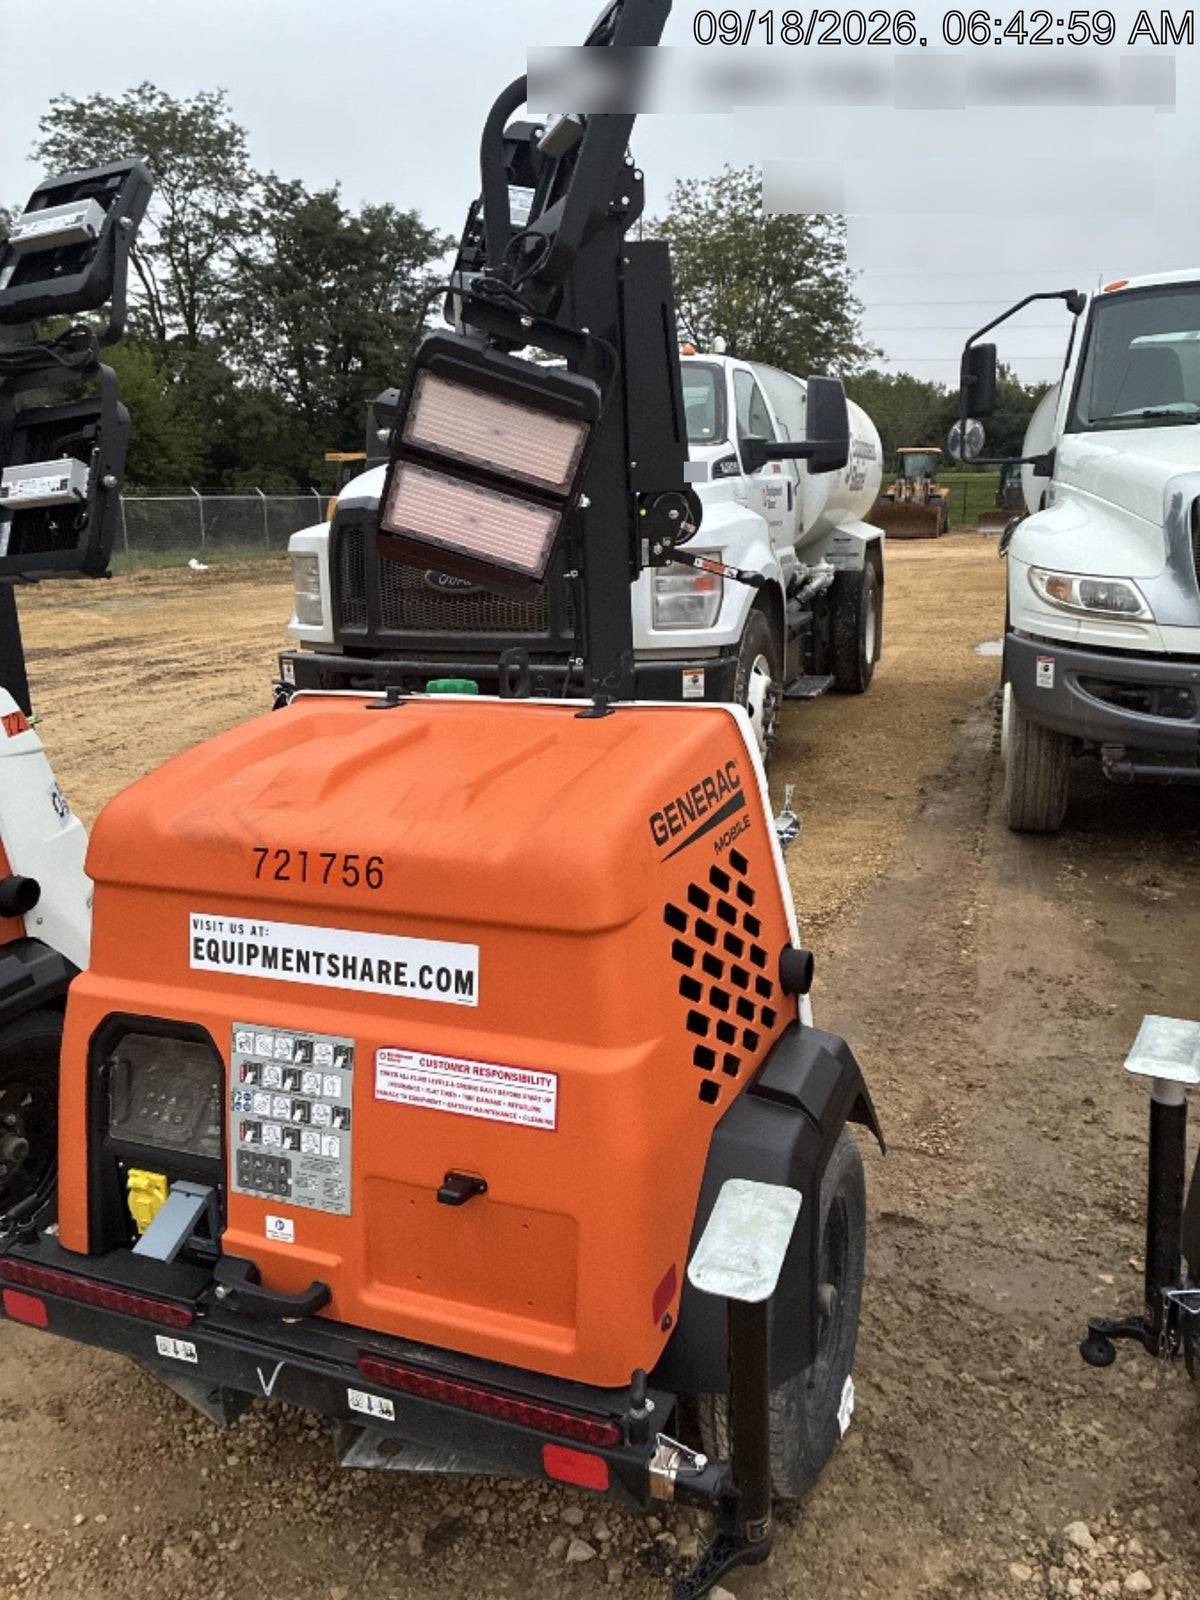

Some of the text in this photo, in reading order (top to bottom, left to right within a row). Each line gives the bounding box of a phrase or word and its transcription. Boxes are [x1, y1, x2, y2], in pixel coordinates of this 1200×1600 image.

[649, 760, 740, 847] GENERAC
[713, 814, 751, 856] MOBILE
[253, 848, 385, 889] 721756
[193, 919, 269, 937] VISIT US AT:
[193, 937, 474, 996] EQUIPMENTSHARE.COM
[418, 1057, 470, 1073] CUSTOMER
[472, 1065, 551, 1086] RESPONSIBILITY
